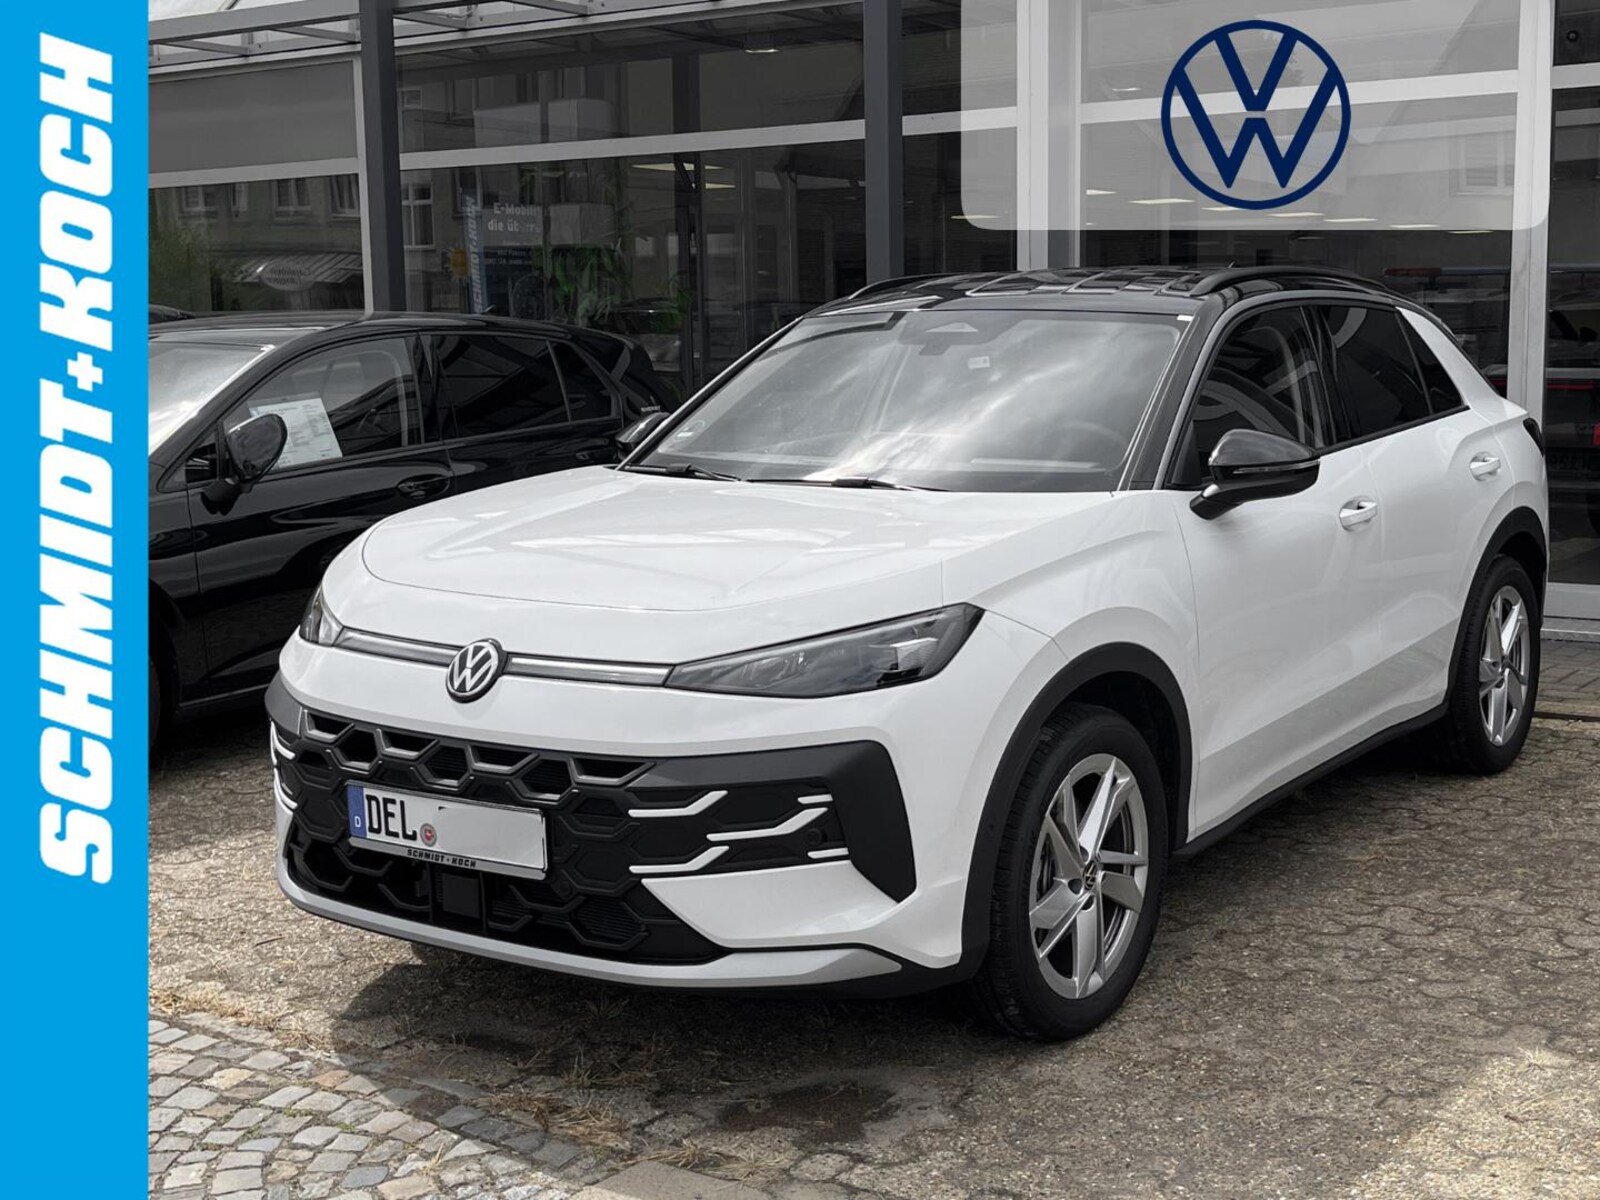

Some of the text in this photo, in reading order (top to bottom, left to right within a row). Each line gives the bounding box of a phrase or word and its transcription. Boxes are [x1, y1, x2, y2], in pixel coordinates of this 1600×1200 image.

[488, 220, 504, 232] die
[354, 815, 361, 828] D
[366, 794, 417, 841] DEL
